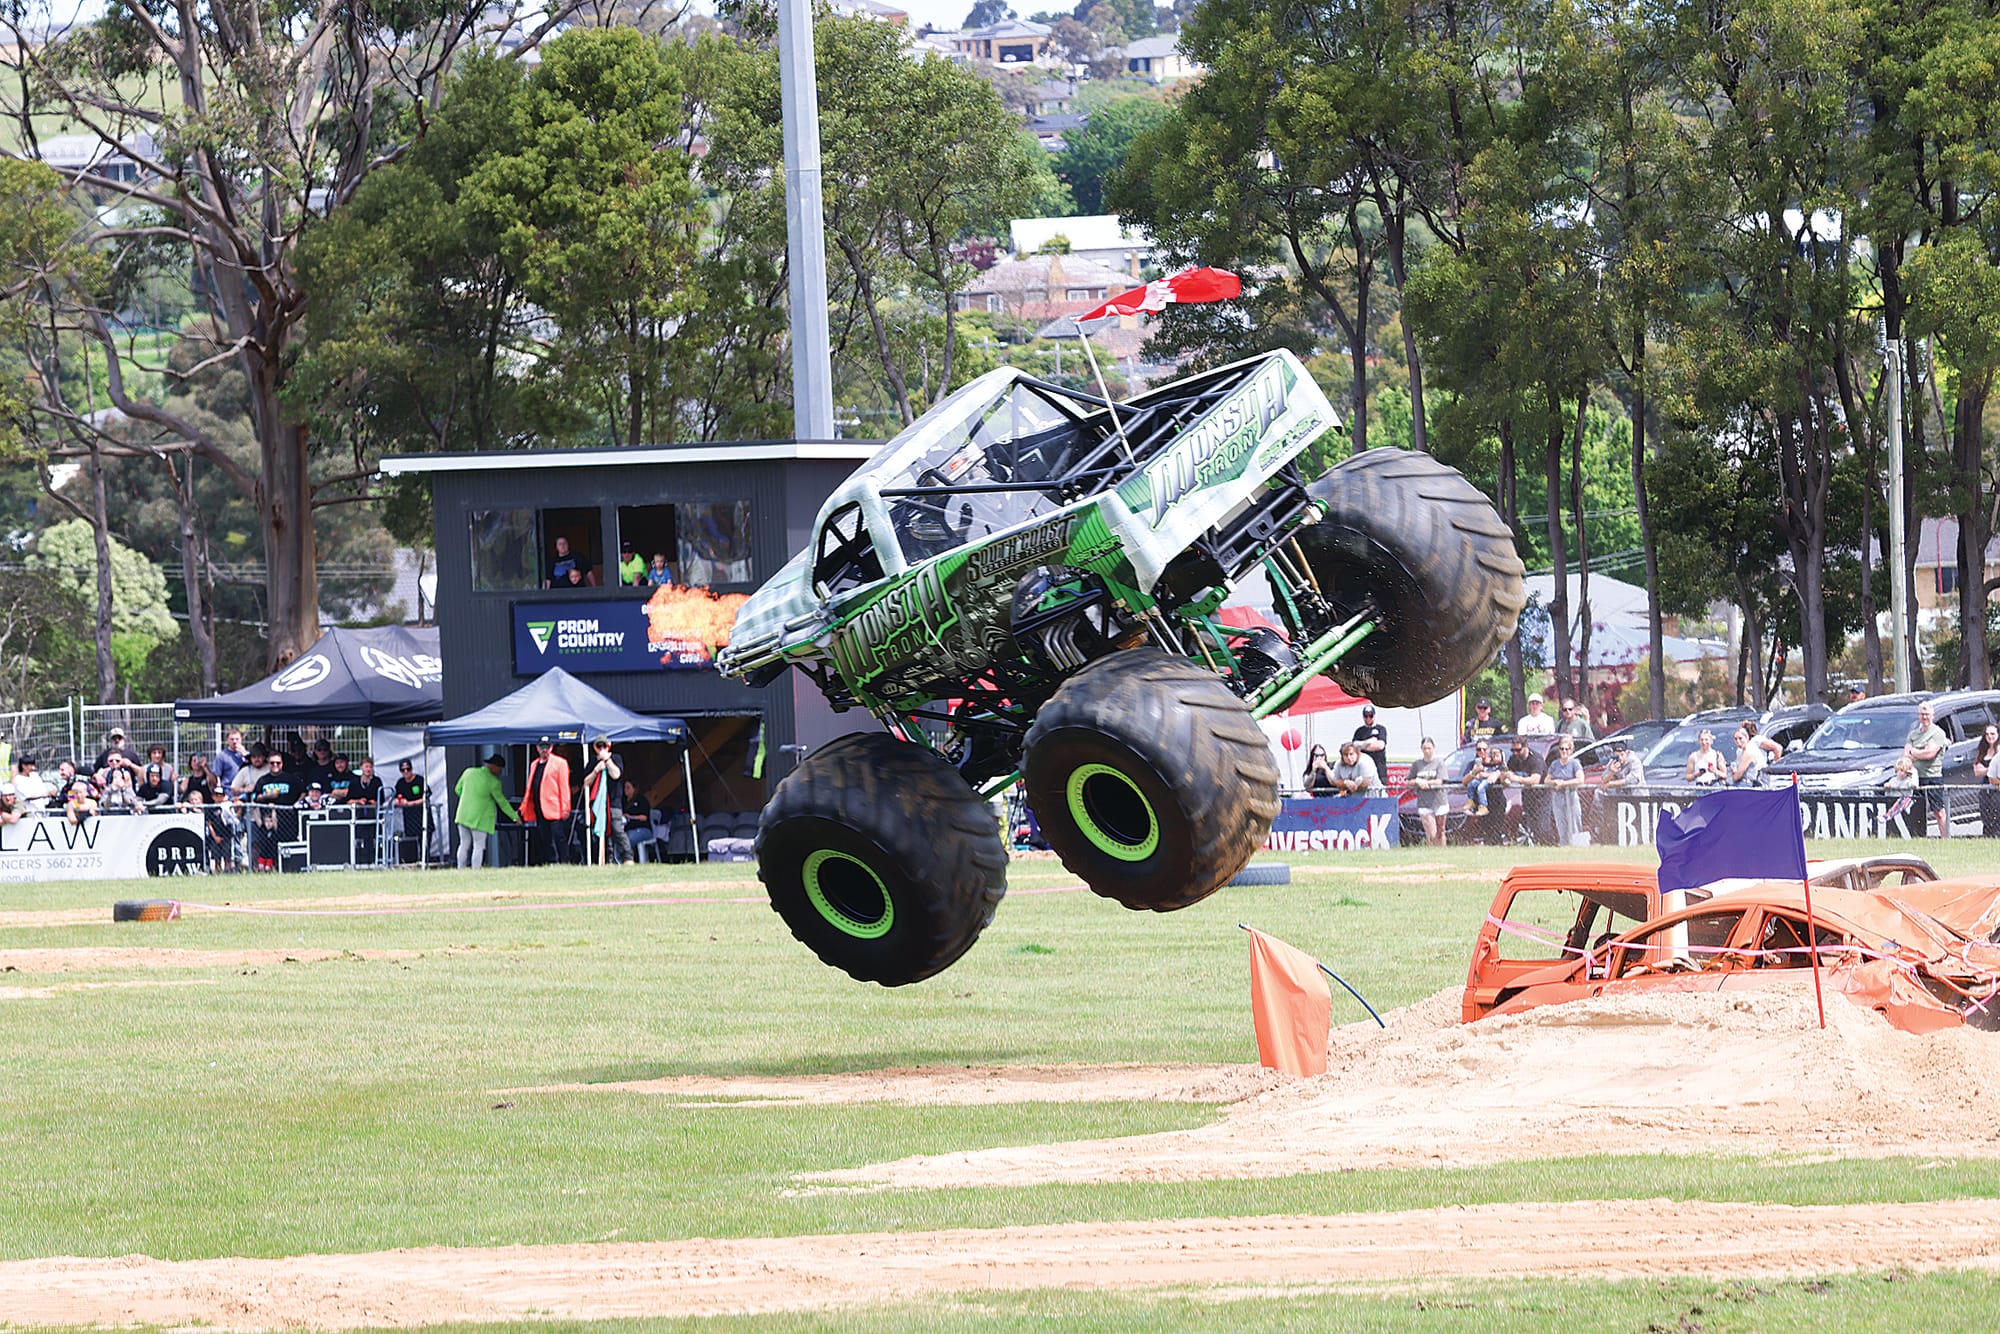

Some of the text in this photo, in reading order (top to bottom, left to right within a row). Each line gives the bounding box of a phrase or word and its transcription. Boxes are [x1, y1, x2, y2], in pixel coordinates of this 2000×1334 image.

[1147, 360, 1288, 530] MONSTA
[1202, 430, 1254, 484] TRON
[968, 536, 1018, 582] SOUTH
[1019, 514, 1078, 551] COAST
[558, 619, 599, 634] PROM
[558, 632, 625, 648] COUNTRY
[831, 560, 955, 690] MONSTA
[879, 627, 923, 668] TRON
[0, 819, 100, 852] LAW
[1266, 813, 1392, 851] IVESTOCK
[0, 856, 103, 870] NCERS 5662 2275
[157, 846, 196, 861] BRB
[158, 862, 201, 877] LAW
